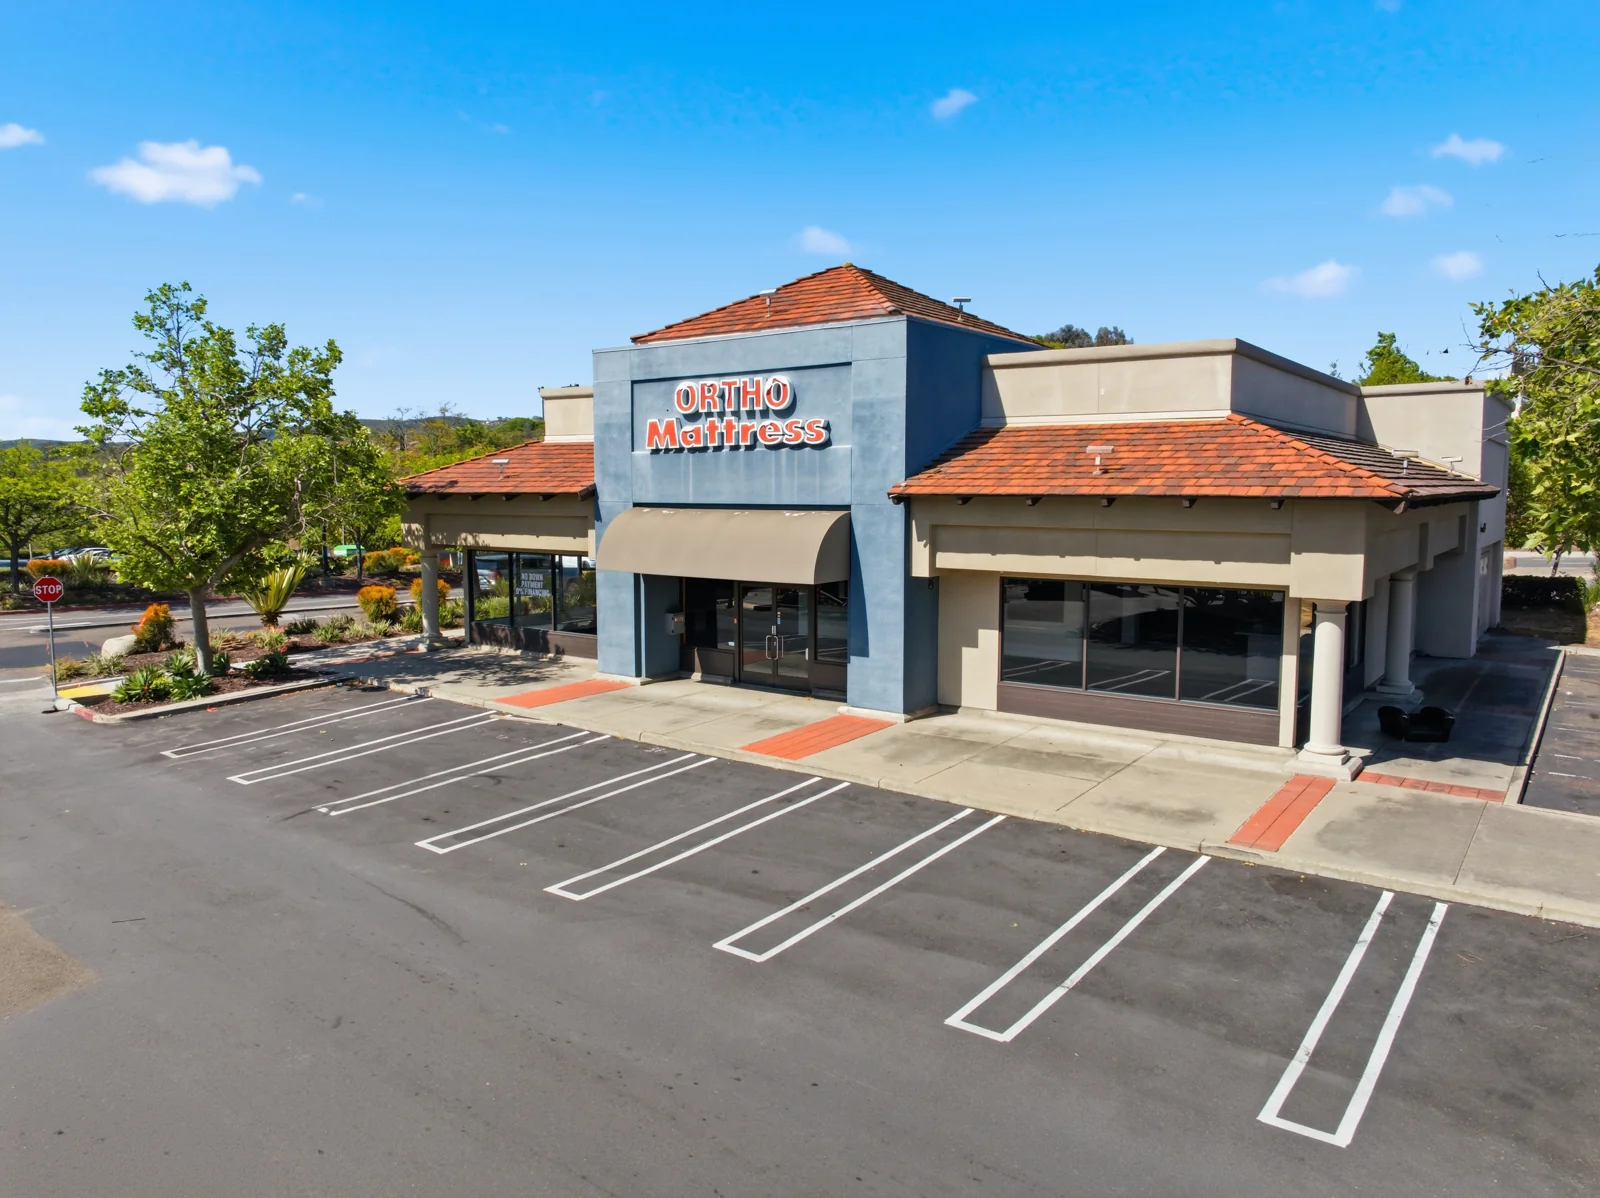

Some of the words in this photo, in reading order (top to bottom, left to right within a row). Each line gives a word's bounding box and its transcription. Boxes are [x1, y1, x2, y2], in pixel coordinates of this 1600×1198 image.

[675, 375, 791, 414] ORTHO
[646, 416, 830, 449] Mattress
[529, 573, 544, 581] DOWN
[35, 585, 62, 595] STOP
[525, 589, 551, 597] FINANCING
